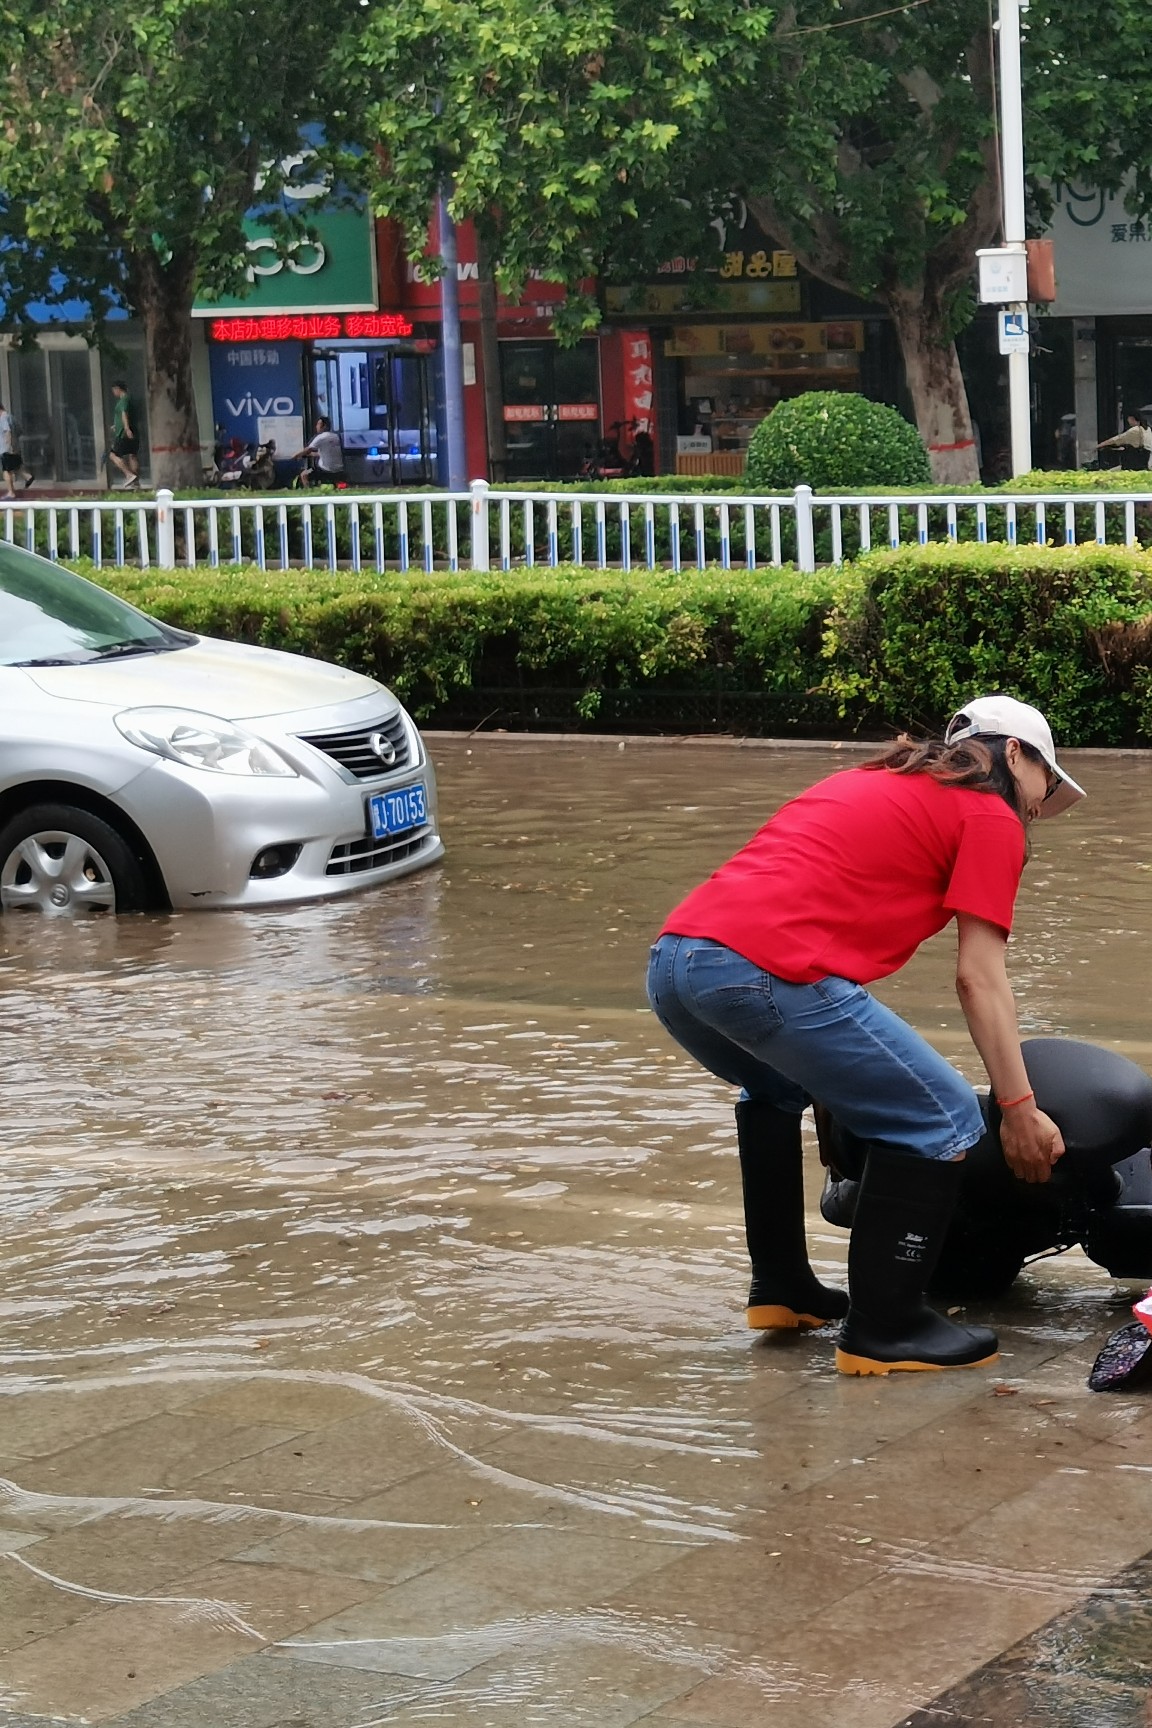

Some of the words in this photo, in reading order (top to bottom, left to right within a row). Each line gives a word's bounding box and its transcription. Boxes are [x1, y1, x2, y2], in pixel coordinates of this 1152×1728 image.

[213, 318, 341, 341] 本店办理移动业务
[227, 349, 280, 367] 中国移动
[225, 392, 295, 417] vivo
